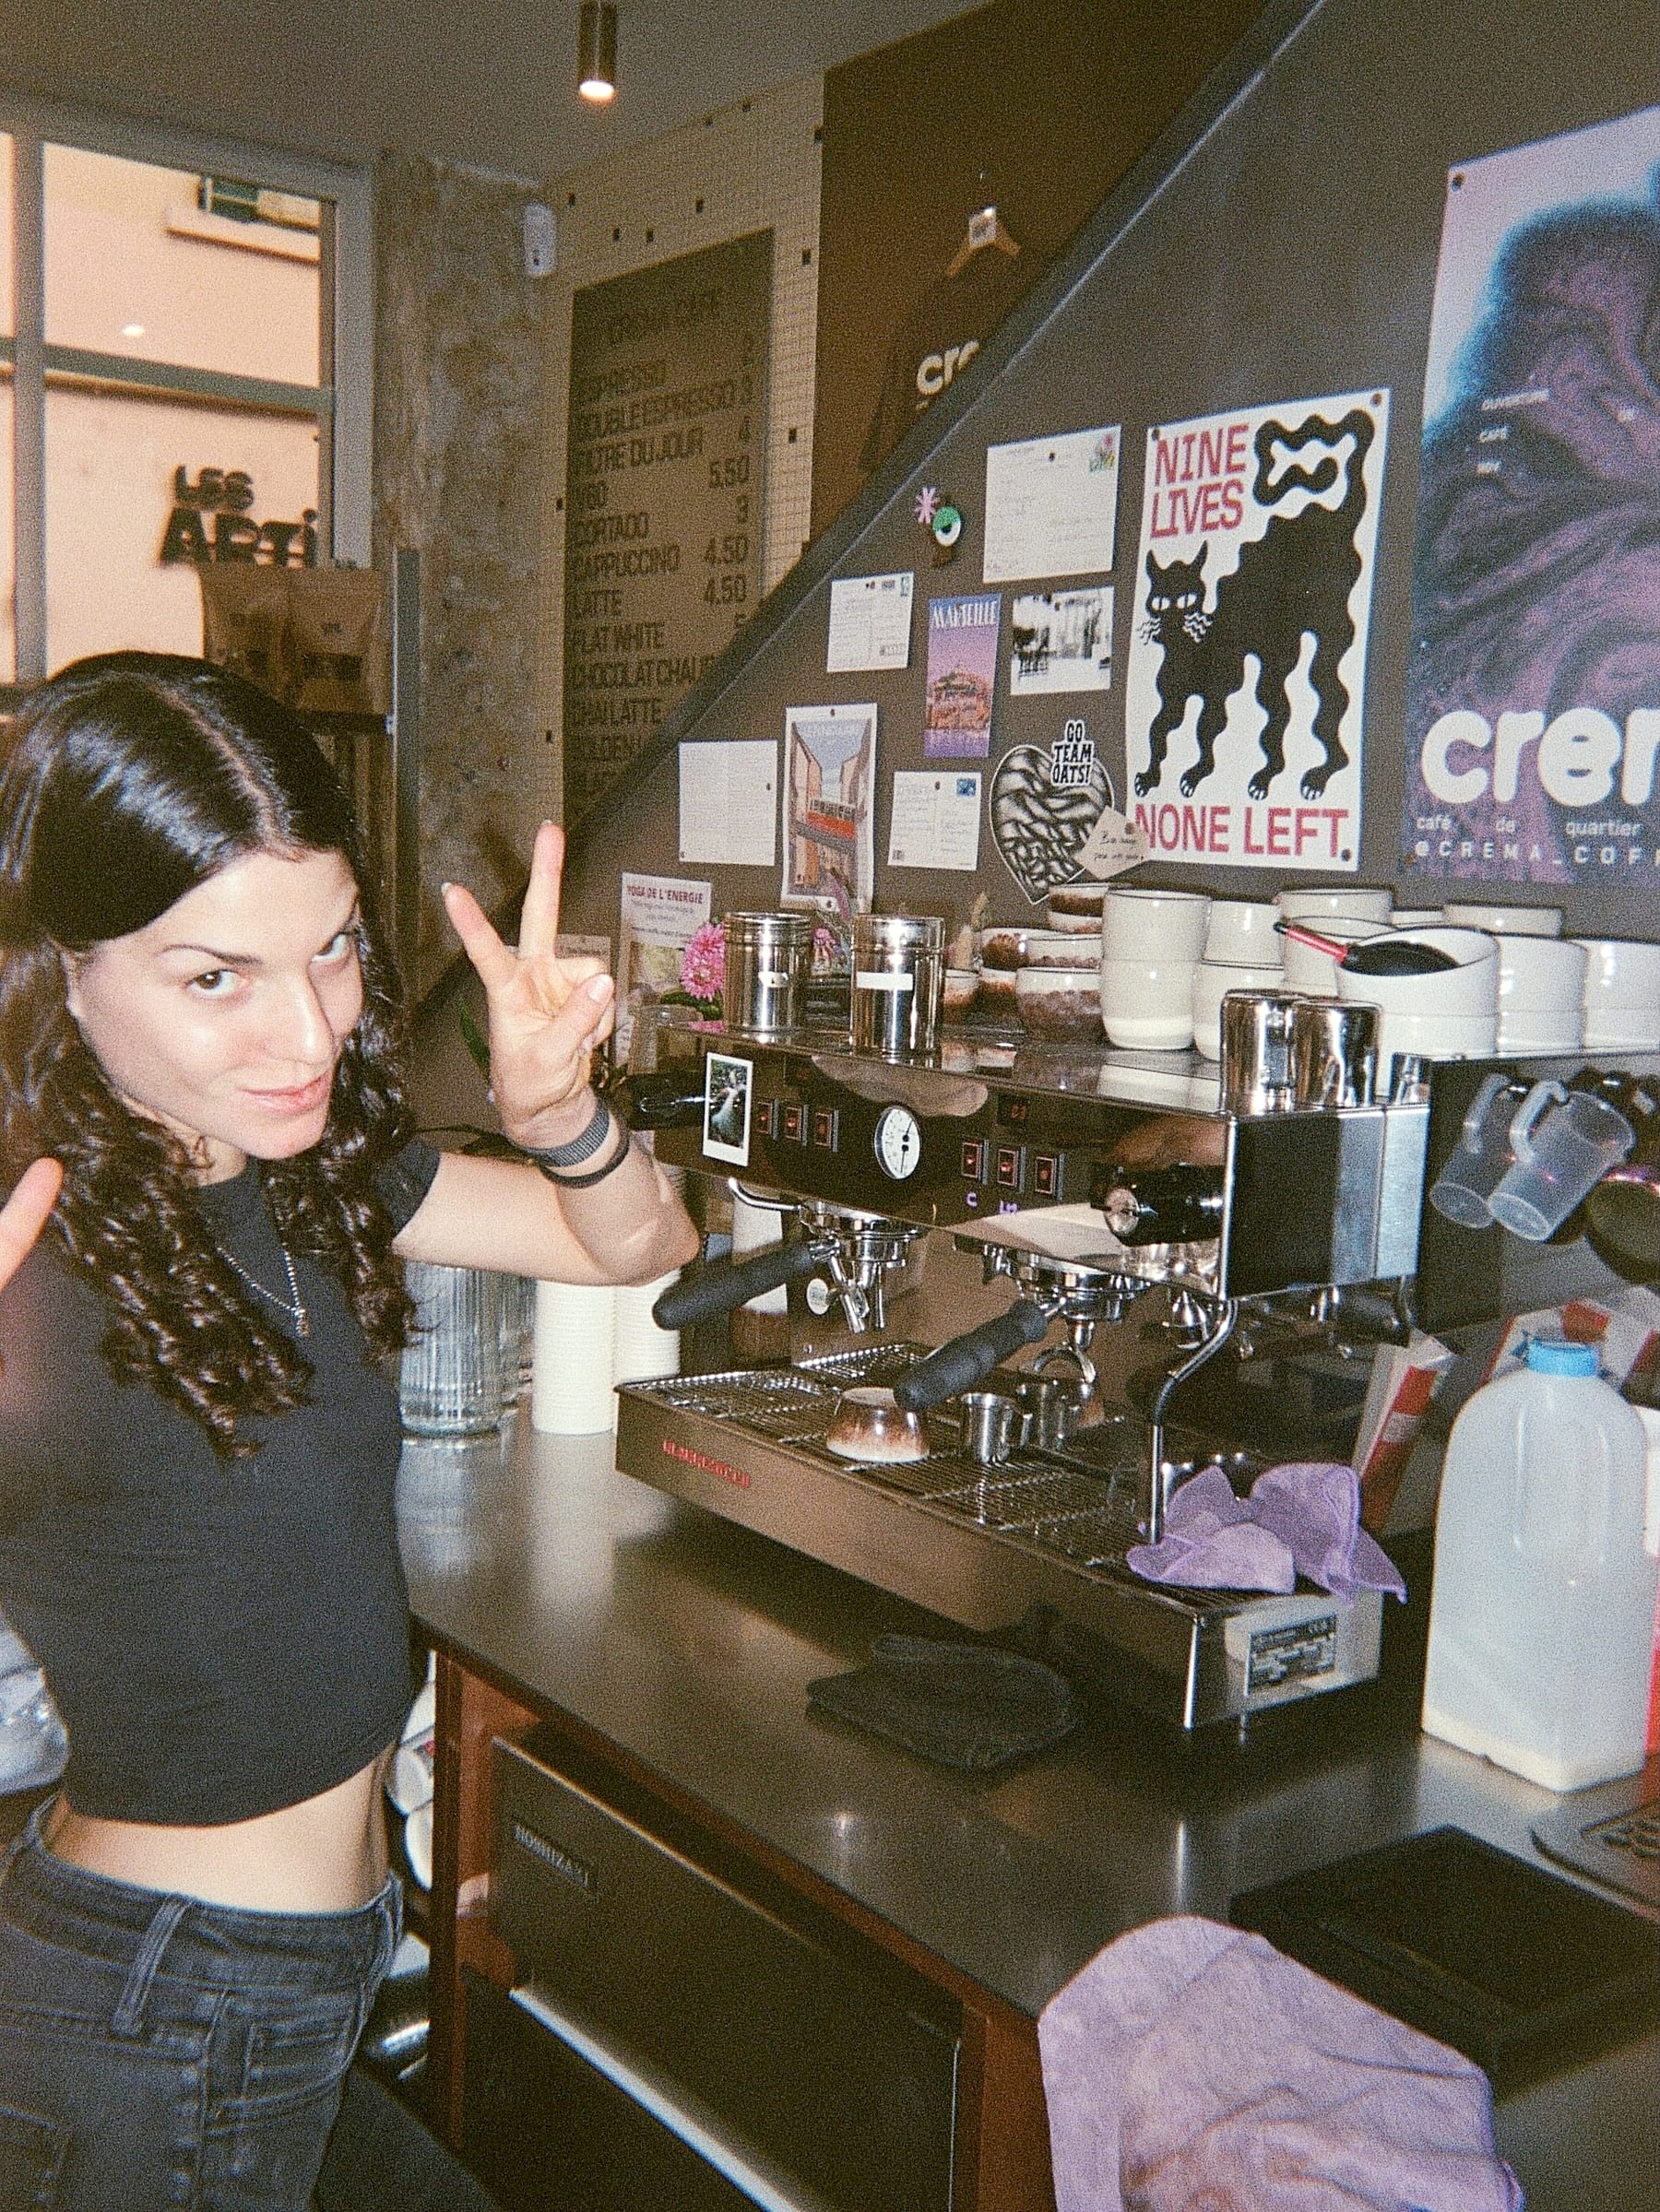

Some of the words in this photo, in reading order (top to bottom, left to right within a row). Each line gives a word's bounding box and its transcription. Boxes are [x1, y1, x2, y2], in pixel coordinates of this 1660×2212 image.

[643, 378, 737, 425] ESPRESSO
[629, 438, 655, 467] DU
[656, 425, 704, 462] JOUR
[1155, 423, 1250, 487] NINE
[175, 465, 255, 510] LES
[708, 455, 751, 488] 5.50
[1151, 479, 1244, 538] LIVES
[572, 512, 649, 549] CORTADO
[571, 544, 681, 583] CAPPUCCINO
[703, 535, 749, 566] 4.50
[572, 590, 624, 620] LATTE
[703, 575, 748, 606] 4.50
[931, 600, 997, 628] MARSEILLE
[571, 626, 610, 655] FLAT
[613, 621, 666, 651] WHITE
[571, 657, 654, 691] CHOCOLAT
[611, 697, 662, 725] LATTE
[1066, 723, 1083, 741] GO
[1054, 744, 1092, 763] TEAM
[1053, 763, 1091, 784] OATS!
[1135, 803, 1230, 853] NONE
[1244, 806, 1349, 858] LEFT
[1565, 820, 1642, 838] quartier
[626, 885, 646, 897] YOGA
[647, 887, 658, 899] DE
